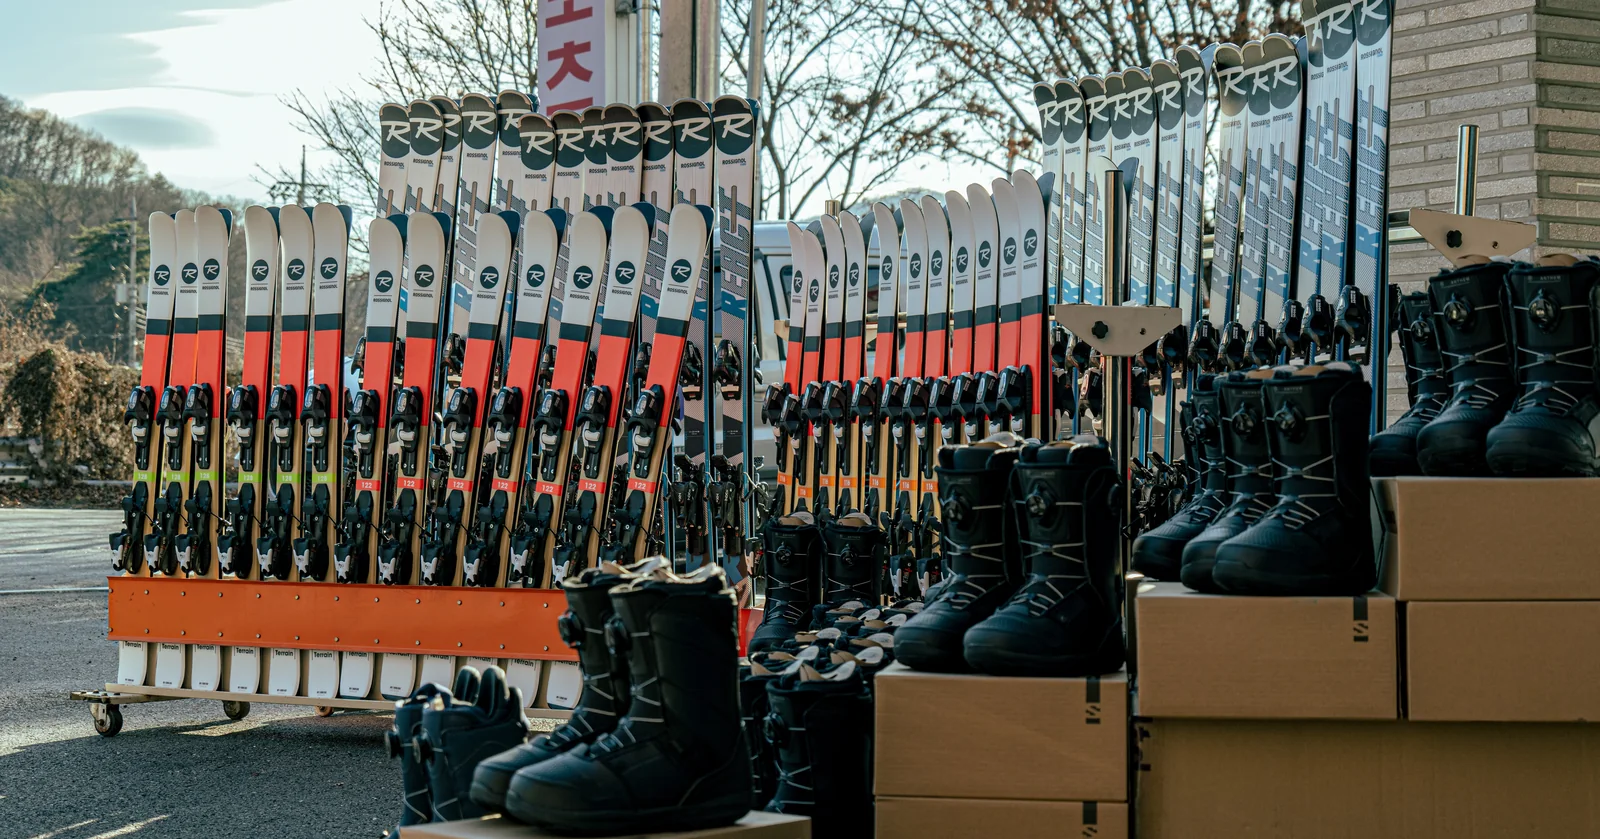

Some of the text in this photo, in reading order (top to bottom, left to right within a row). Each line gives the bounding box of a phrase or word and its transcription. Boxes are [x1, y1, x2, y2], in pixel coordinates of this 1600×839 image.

[1265, 55, 1298, 89] R
[1311, 72, 1324, 80] ROSSIG
[1180, 67, 1204, 97] R
[1217, 66, 1246, 97] R
[1126, 87, 1153, 117] R
[1154, 81, 1181, 111] R
[1038, 100, 1060, 128] R
[1057, 97, 1083, 125] R
[1086, 95, 1109, 124] R
[461, 111, 497, 135] R
[714, 113, 753, 138] R
[381, 120, 410, 145] R
[409, 117, 443, 142] R
[604, 121, 641, 146] R
[643, 120, 673, 144] R
[673, 117, 711, 142] R
[519, 131, 556, 155] R
[556, 129, 585, 152] R
[1025, 236, 1036, 249] R
[980, 248, 991, 260] R
[1004, 245, 1015, 257] R
[911, 260, 920, 271] R
[932, 257, 941, 269] R
[957, 254, 968, 266] R
[183, 269, 197, 279] R
[204, 265, 218, 275] R
[253, 266, 268, 276] R
[288, 265, 304, 275] R
[322, 264, 337, 274] R
[617, 267, 634, 279] R
[673, 265, 690, 278] R
[850, 269, 859, 280] R
[882, 263, 892, 274] R
[155, 271, 169, 281] R
[377, 276, 392, 287] R
[416, 271, 433, 282] R
[482, 272, 498, 284] R
[528, 270, 544, 282] R
[575, 272, 592, 284] R
[830, 271, 839, 282] R
[794, 278, 802, 288] R
[811, 286, 819, 296] R
[497, 481, 508, 489] 122
[542, 484, 553, 492] 122
[585, 482, 597, 490] 122
[634, 481, 646, 490] 122
